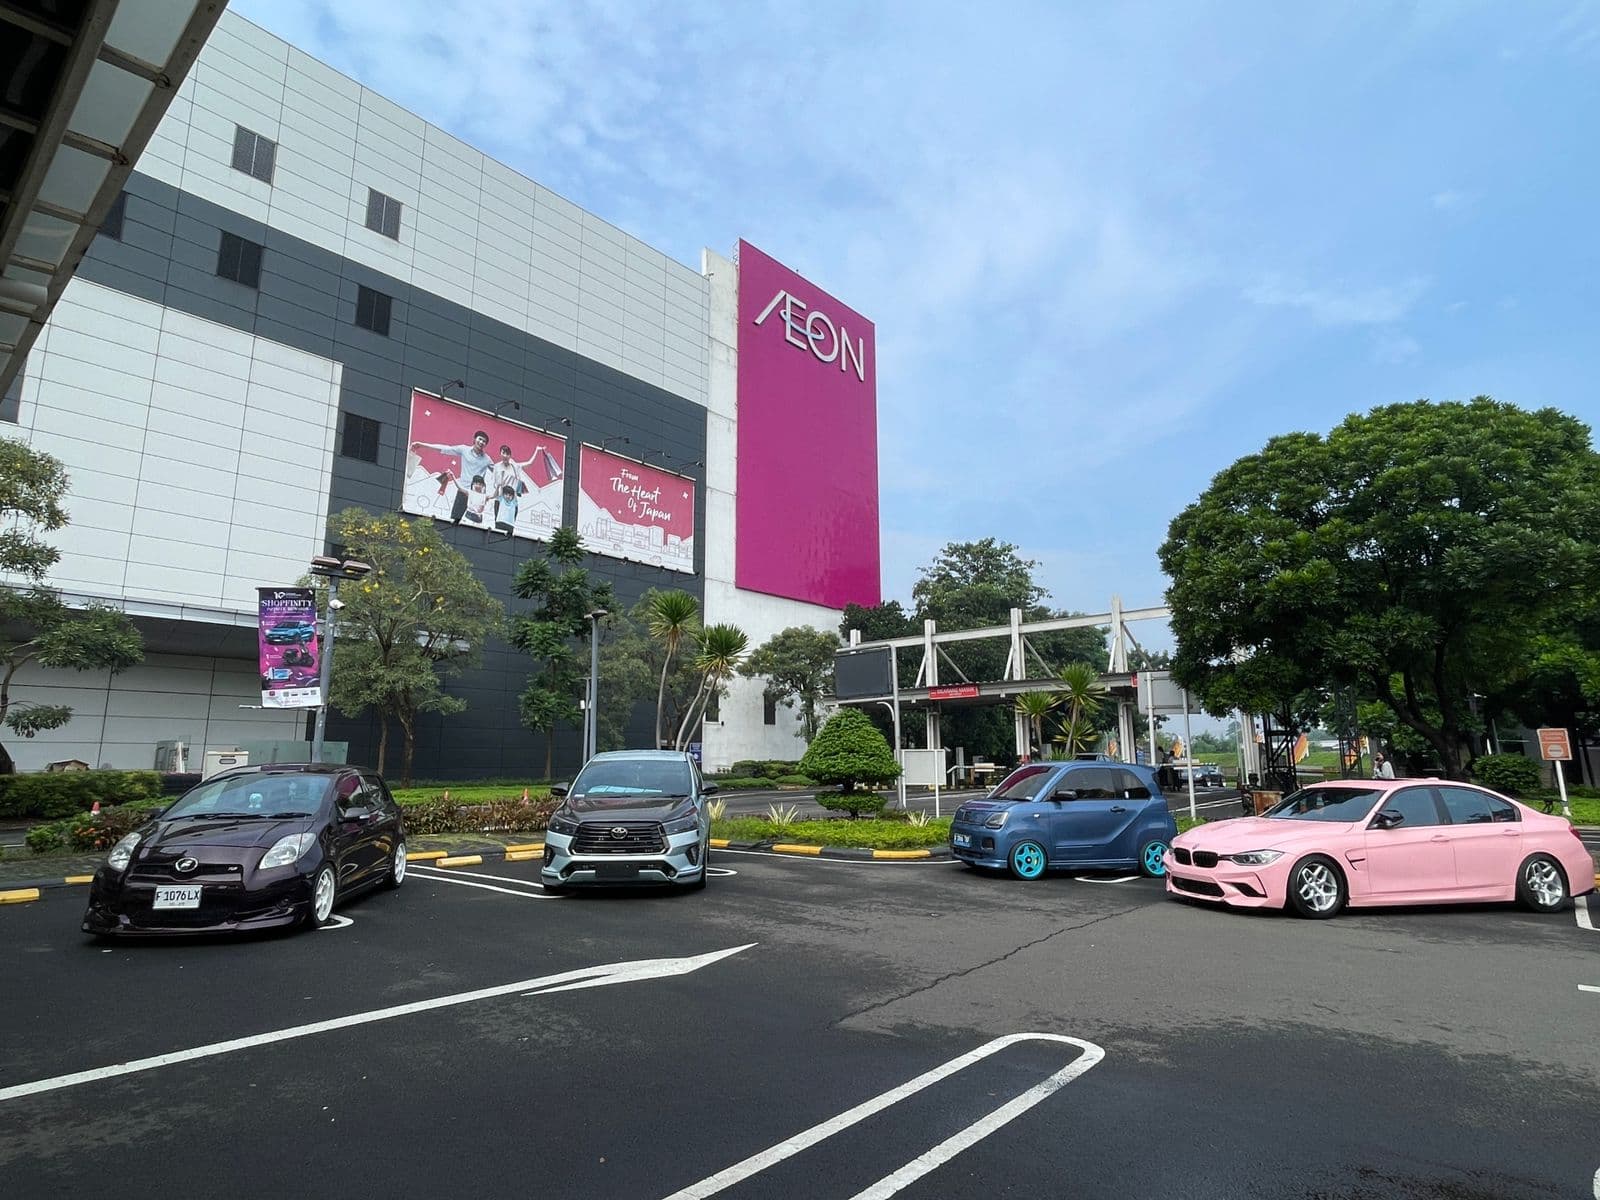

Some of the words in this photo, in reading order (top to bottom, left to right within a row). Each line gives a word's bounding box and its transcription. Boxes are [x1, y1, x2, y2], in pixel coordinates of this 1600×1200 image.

[621, 469, 638, 480] From
[610, 477, 630, 492] The
[631, 485, 661, 504] Heart
[628, 497, 638, 512] Of
[638, 502, 670, 521] Japan
[156, 891, 162, 900] F
[163, 890, 186, 900] 1076
[188, 890, 200, 900] LX
